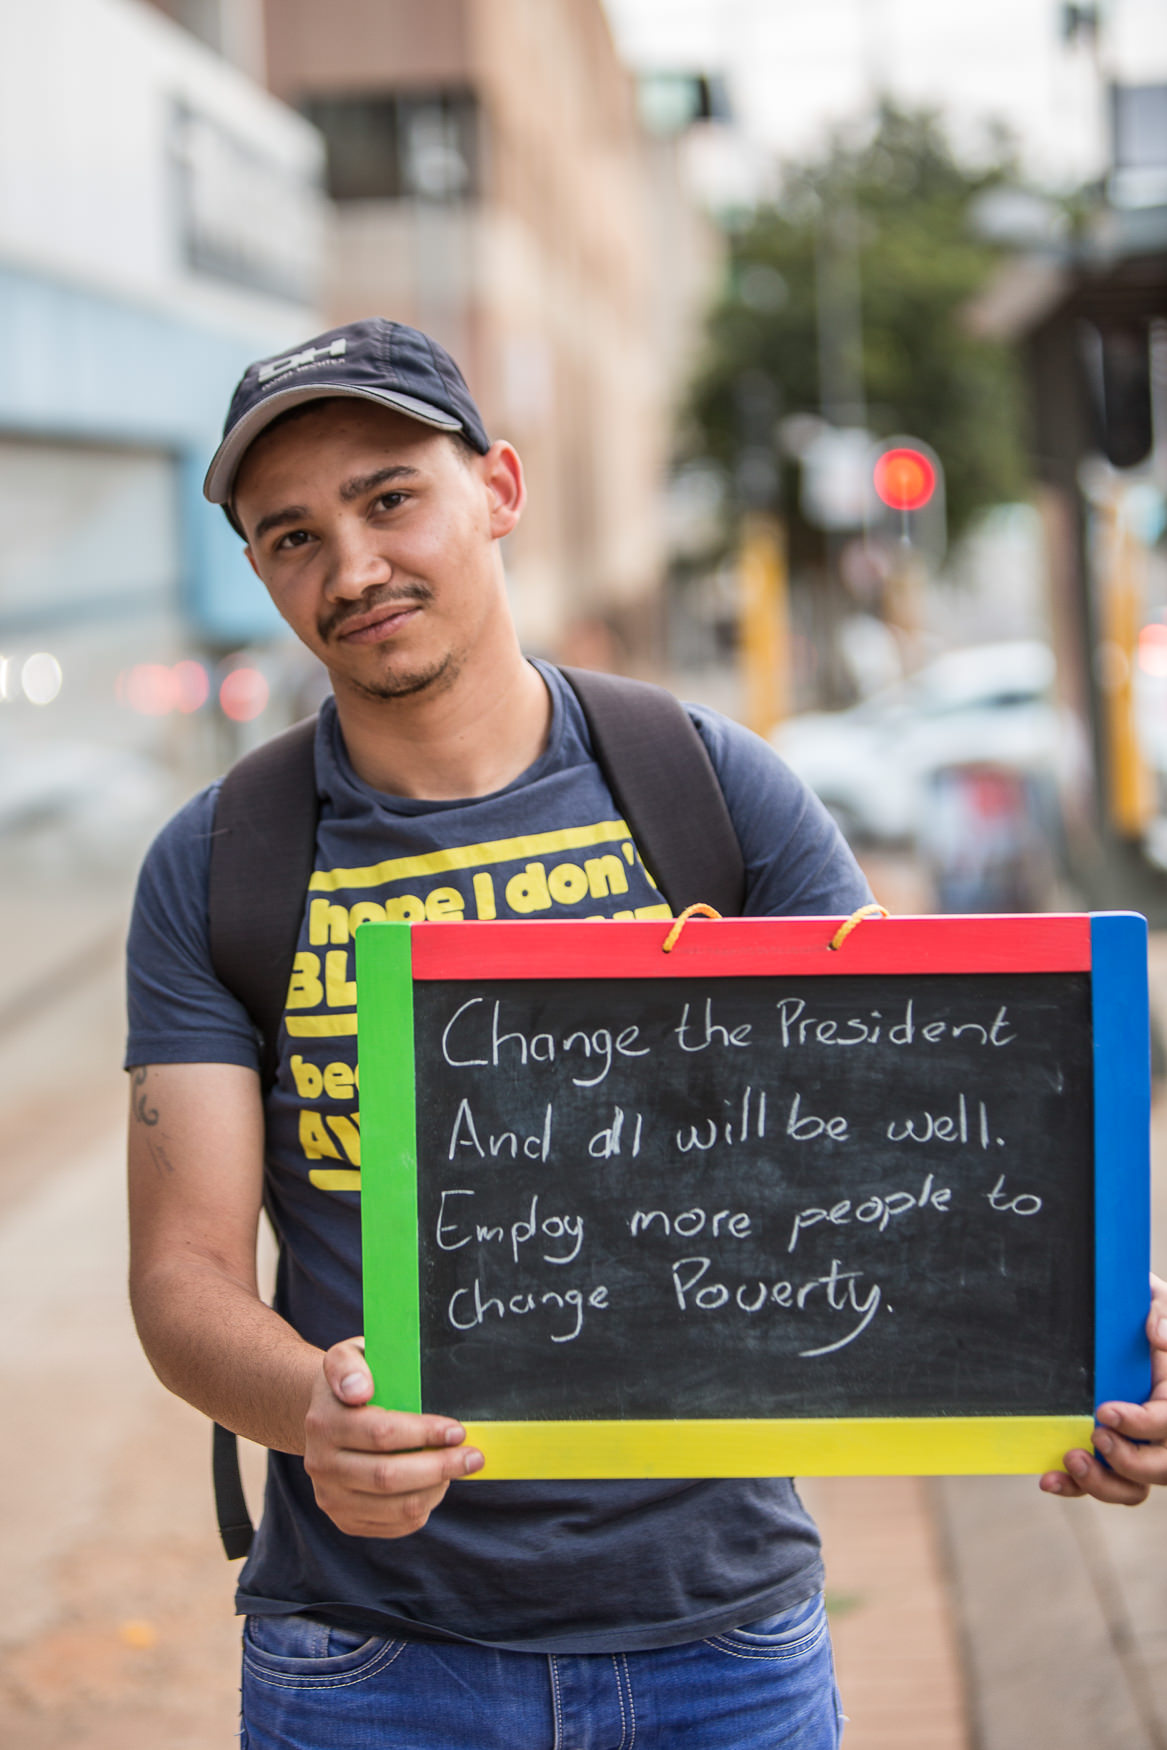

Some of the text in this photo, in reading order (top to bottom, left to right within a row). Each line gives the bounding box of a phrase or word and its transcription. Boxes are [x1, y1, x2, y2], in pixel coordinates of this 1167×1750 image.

[472, 872, 497, 921] I
[505, 842, 657, 914] don'
[442, 997, 1017, 1087] Change the President
[449, 1085, 1005, 1163] And all will be well.
[630, 1207, 752, 1238] more
[787, 1173, 952, 1253] people
[986, 1174, 1042, 1215] to
[672, 1256, 894, 1357] Poverty.
